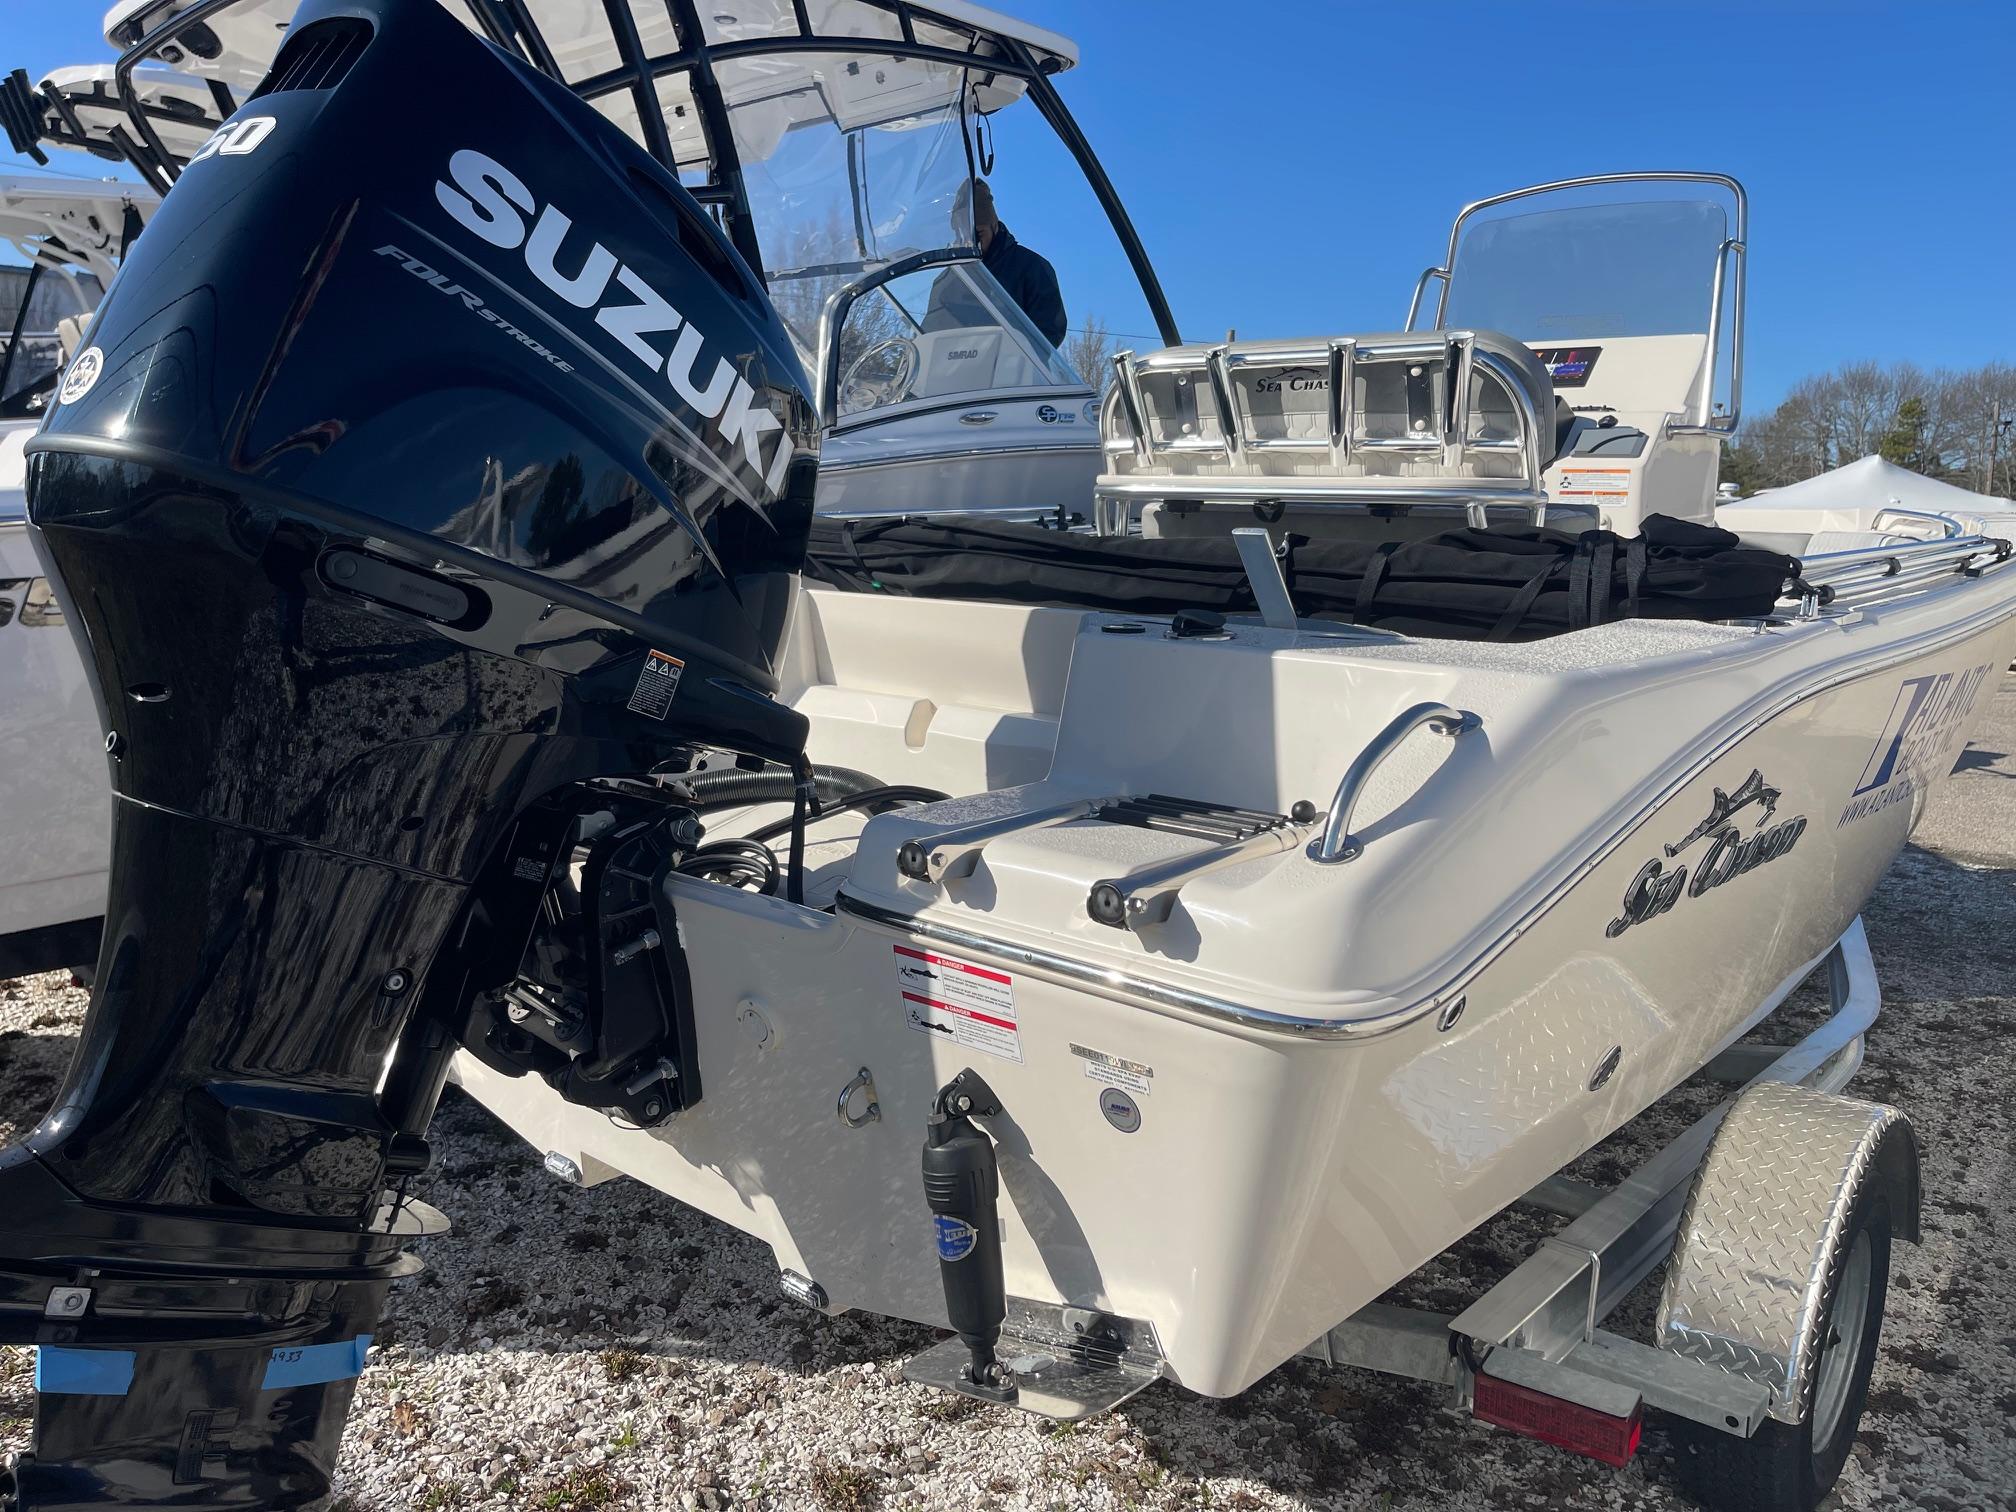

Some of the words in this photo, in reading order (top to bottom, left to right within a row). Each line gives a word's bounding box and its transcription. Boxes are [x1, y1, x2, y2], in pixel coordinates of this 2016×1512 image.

[435, 149, 795, 497] SUZUKI
[1256, 379, 1282, 393] SEA
[1290, 376, 1329, 392] CHAS
[942, 960, 965, 970] DANGER
[949, 1006, 972, 1016] DANGER
